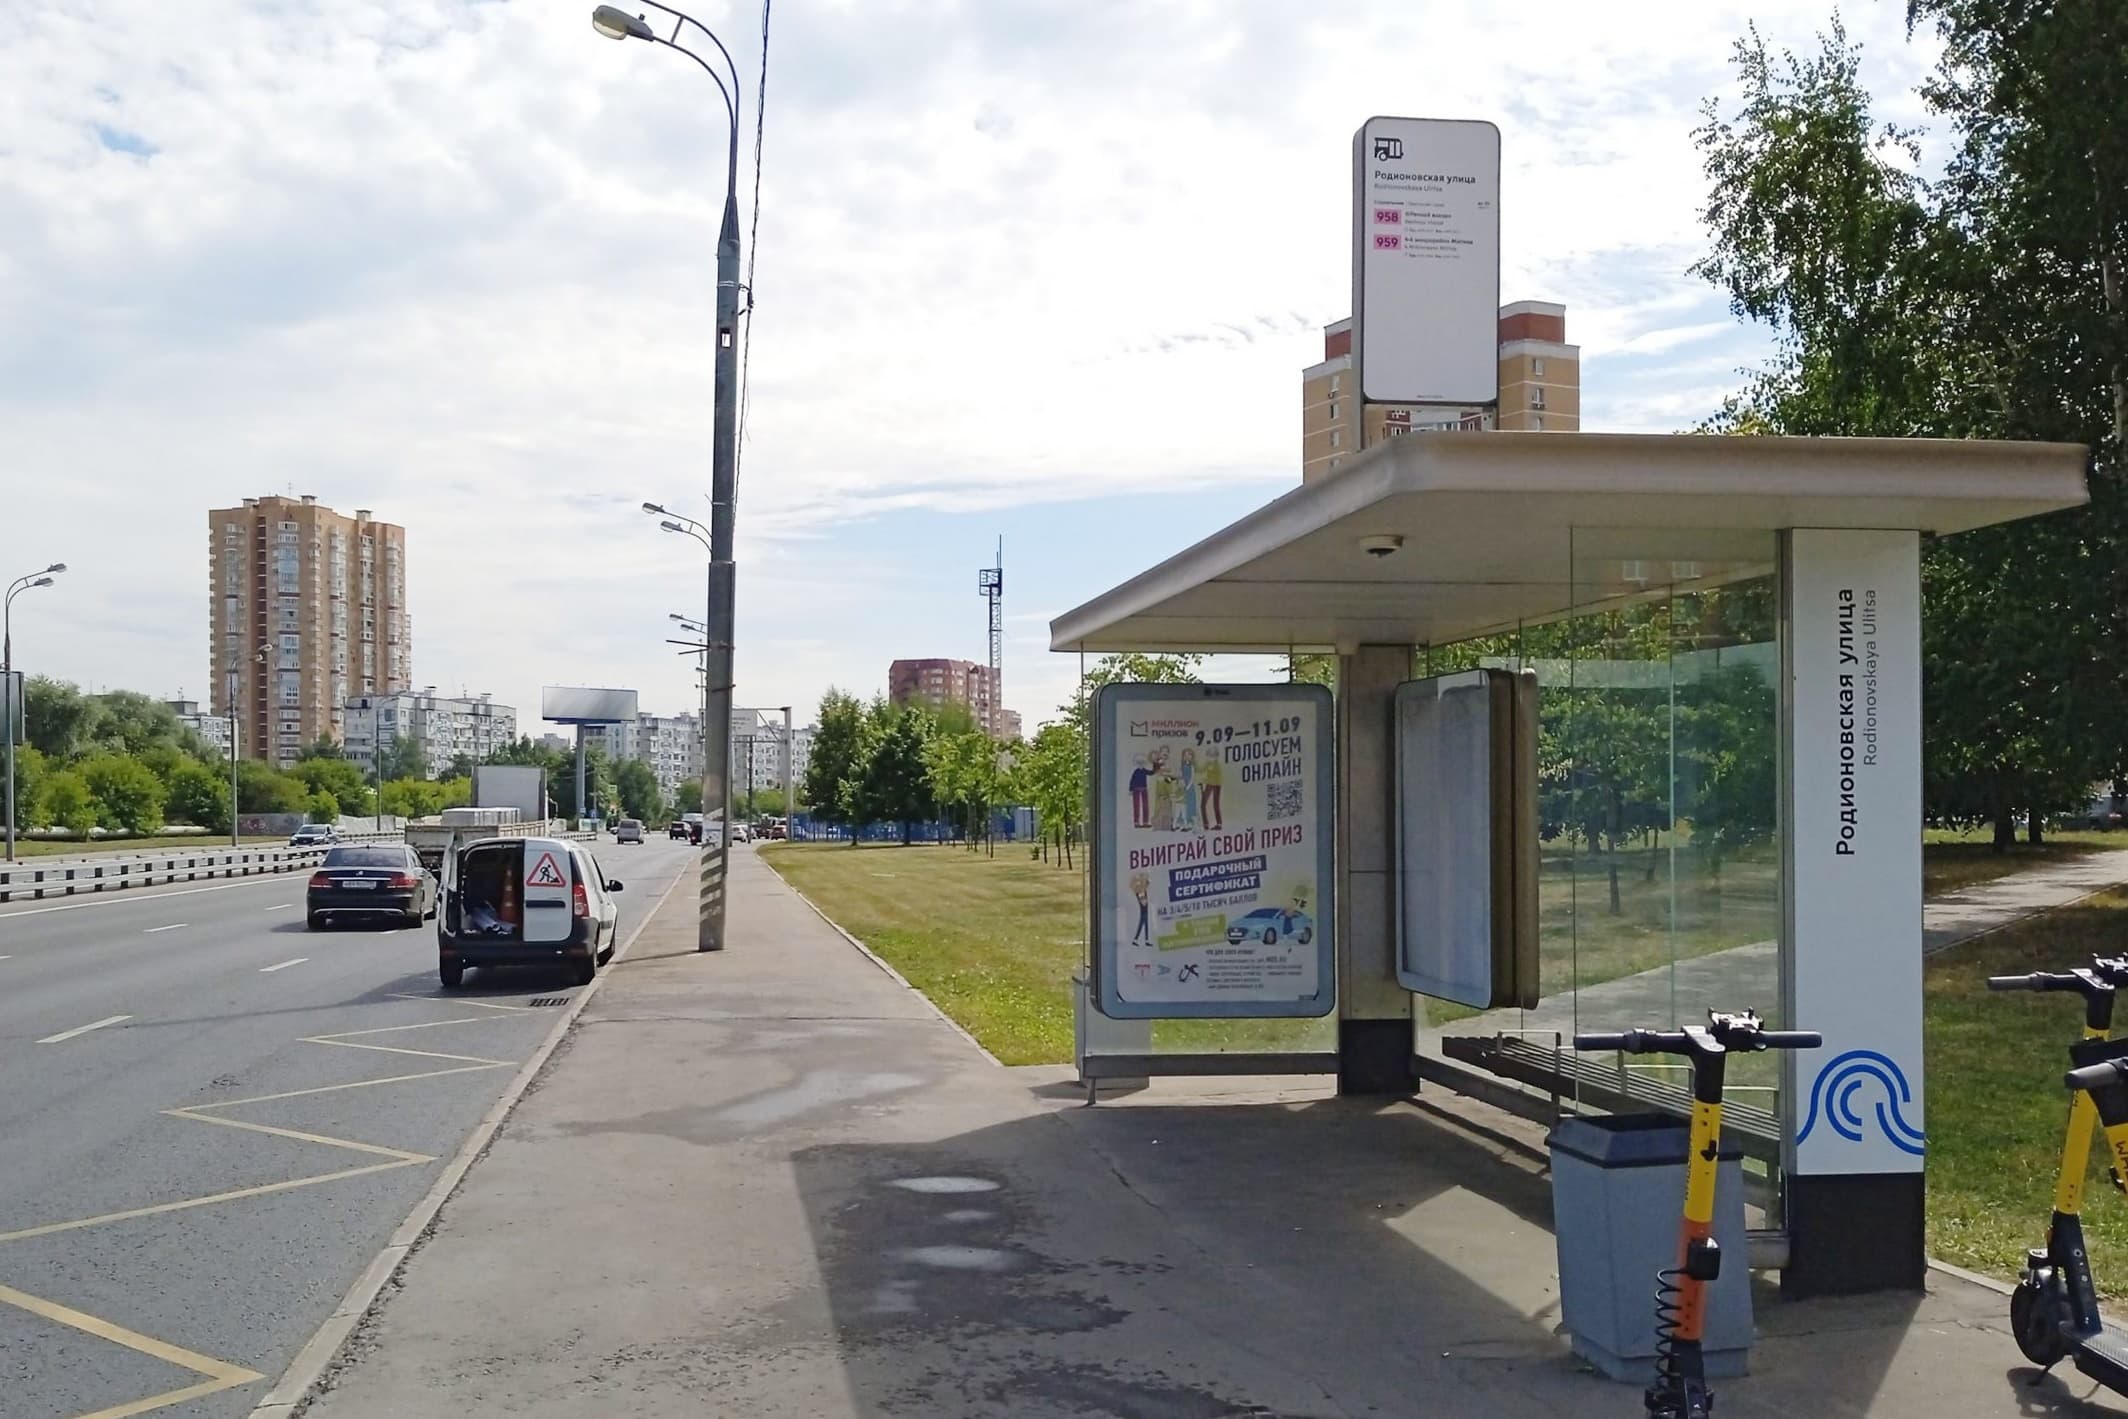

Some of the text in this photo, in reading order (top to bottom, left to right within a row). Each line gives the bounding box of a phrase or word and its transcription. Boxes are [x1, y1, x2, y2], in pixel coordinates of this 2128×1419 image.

[1374, 170, 1476, 185] Родионовская улица
[1376, 211, 1399, 223] 958
[1376, 237, 1399, 248] 959
[1862, 589, 1880, 766] Rodionovskaya Ulitsa
[1836, 588, 1858, 856] Родионовская улица
[1224, 735, 1301, 764] ГОЛОСУЕМ
[1241, 755, 1302, 783] ОНЛАЙН
[1129, 824, 1303, 870] ВЫИГРАЙ СВОЙ ПРИЗ
[1175, 856, 1262, 881] ПОДАРОЧНЫЙ
[1175, 876, 1257, 897] СЕРТИФИКАТ
